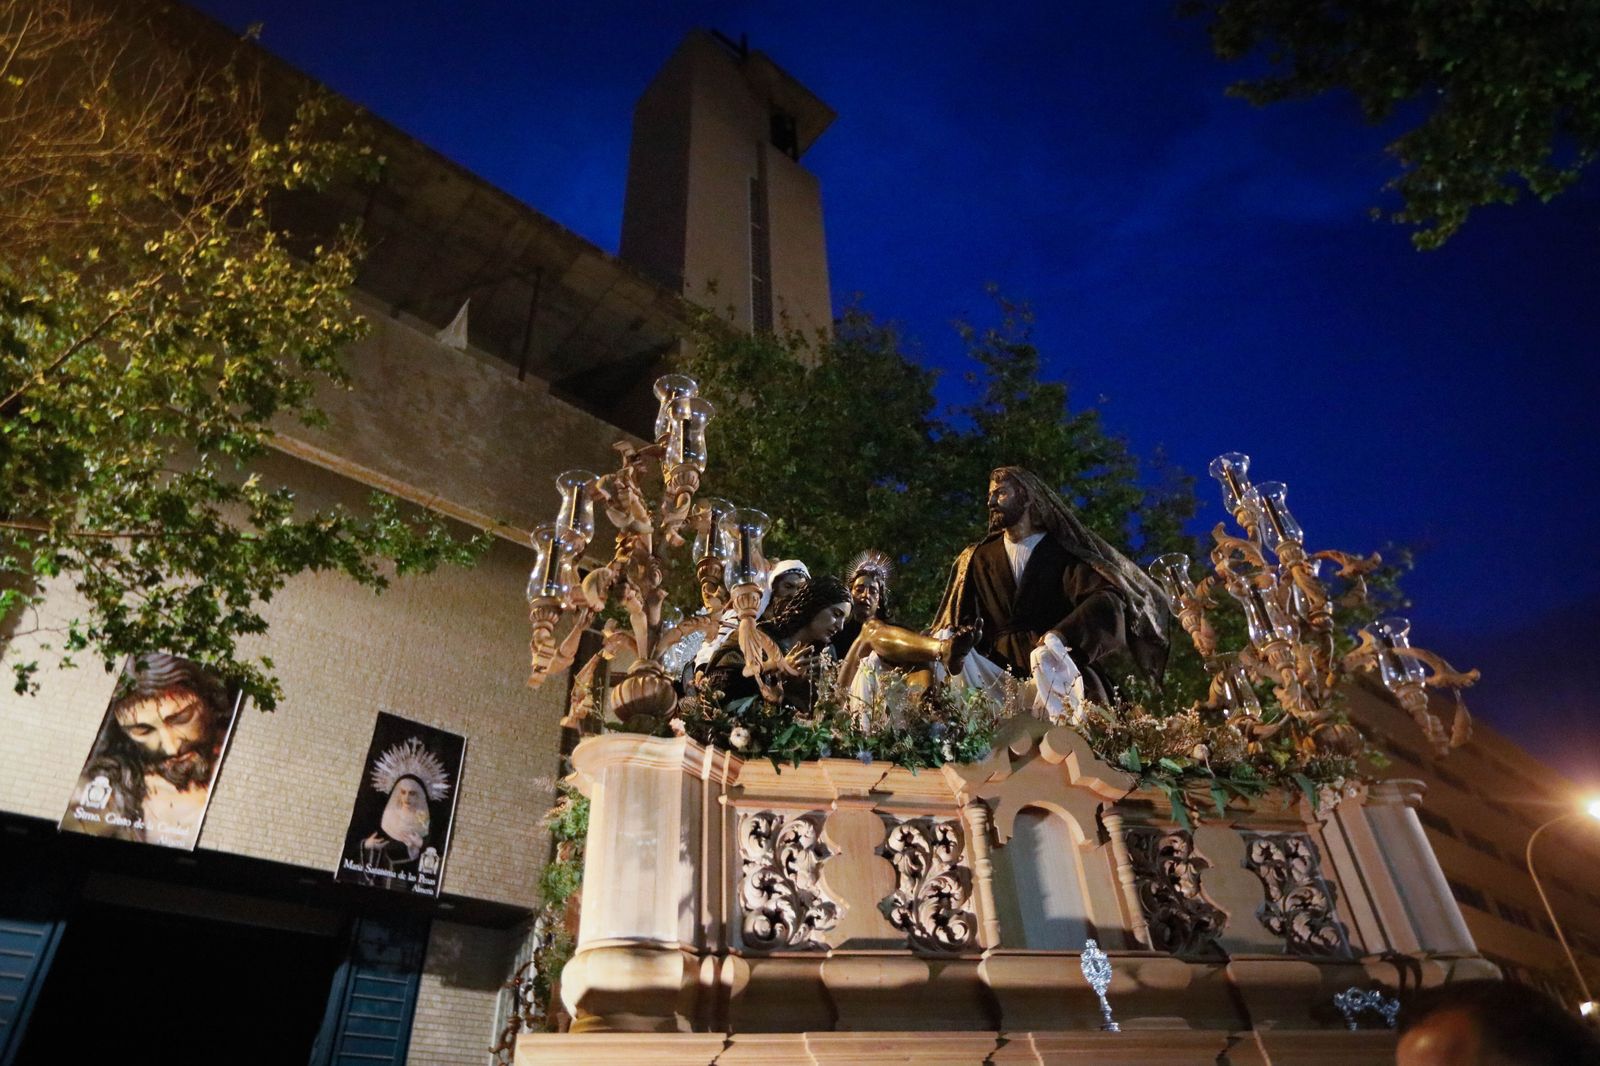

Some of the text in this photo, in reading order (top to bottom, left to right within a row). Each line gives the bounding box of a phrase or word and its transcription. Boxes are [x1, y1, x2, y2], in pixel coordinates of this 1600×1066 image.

[397, 870, 407, 880] de
[407, 872, 417, 882] las
[418, 873, 436, 886] Penas
